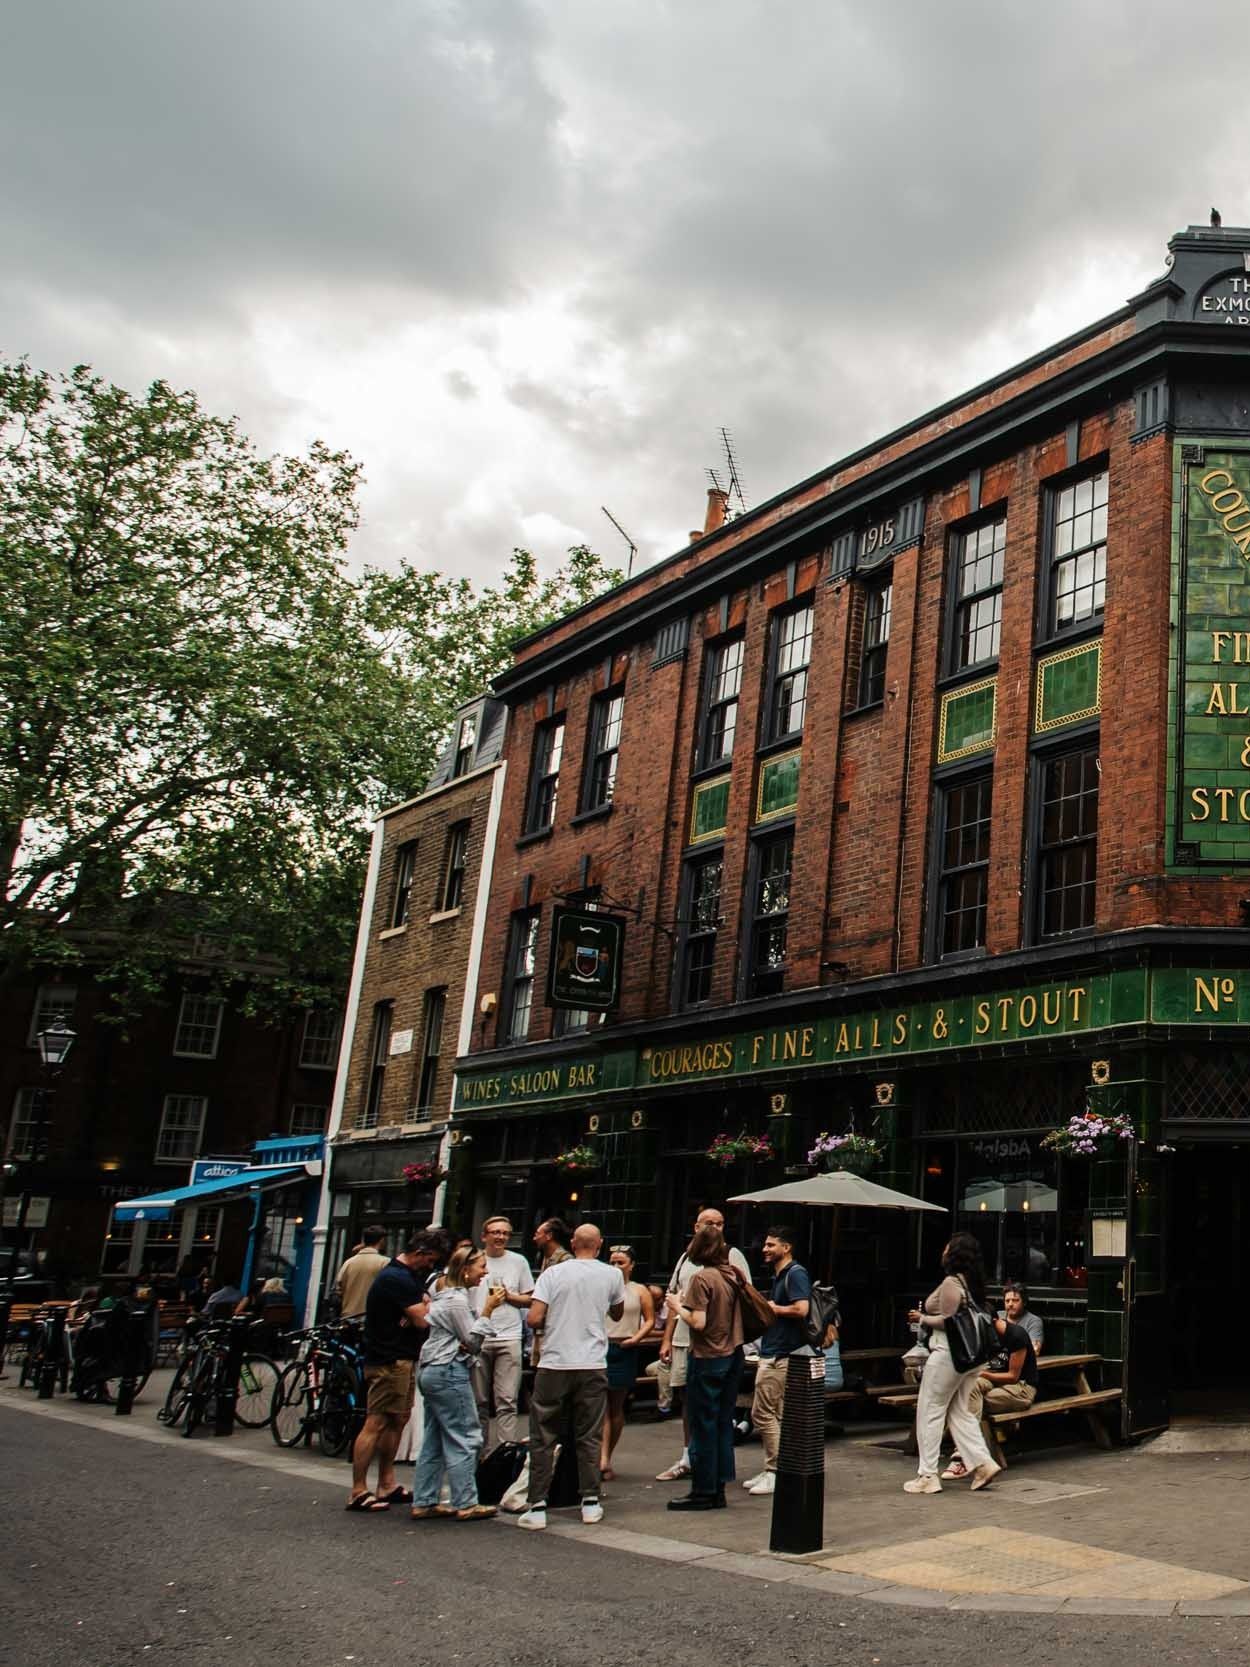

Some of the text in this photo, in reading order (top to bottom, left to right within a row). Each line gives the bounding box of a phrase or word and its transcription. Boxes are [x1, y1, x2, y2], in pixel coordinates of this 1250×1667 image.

[861, 519, 895, 556] 1915
[650, 1041, 733, 1077] COURAGES
[751, 1027, 815, 1064] FINE
[932, 1008, 949, 1040] &
[975, 987, 1086, 1034] STOUT
[462, 1063, 596, 1100] WINES SALOON BAR
